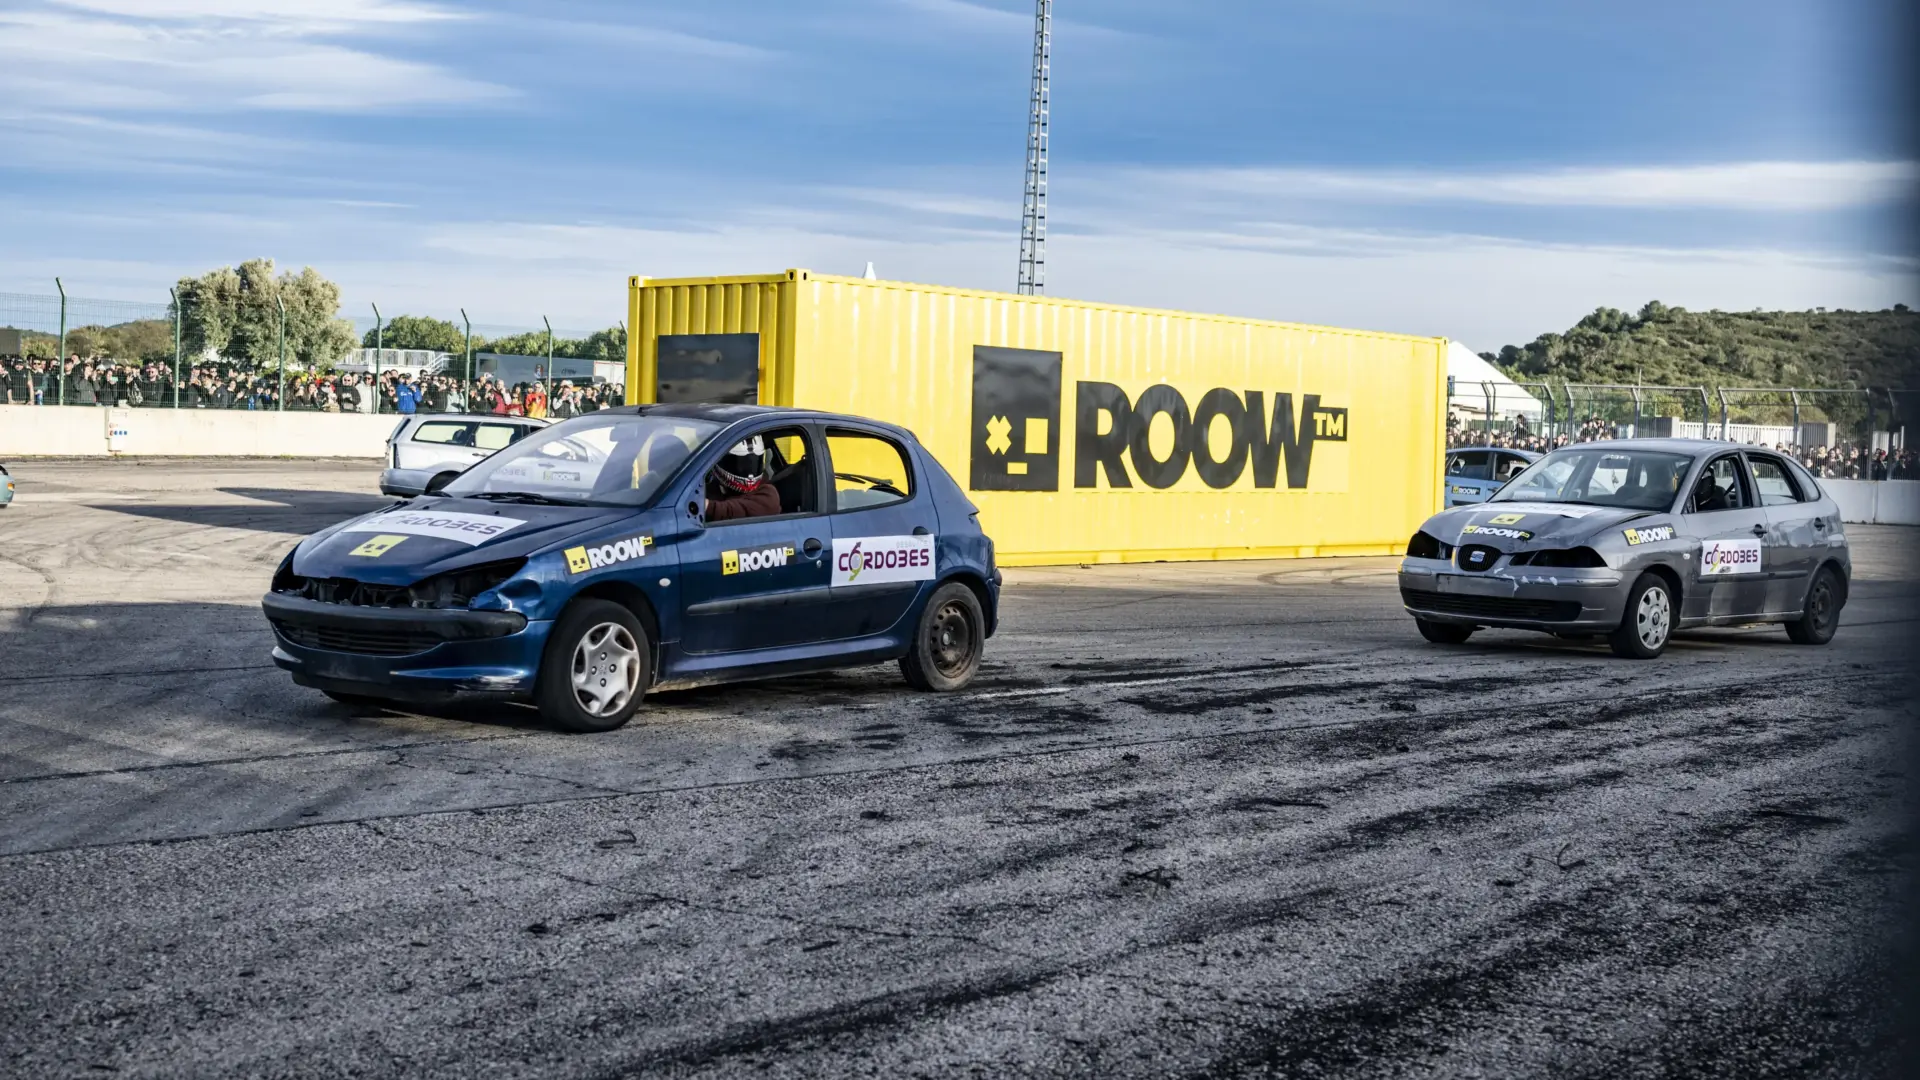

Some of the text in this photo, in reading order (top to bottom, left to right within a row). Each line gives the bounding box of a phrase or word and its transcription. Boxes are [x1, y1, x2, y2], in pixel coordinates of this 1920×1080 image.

[1637, 526, 1670, 543] ROOW
[587, 536, 646, 569] ROOW
[739, 547, 788, 572] ROOW
